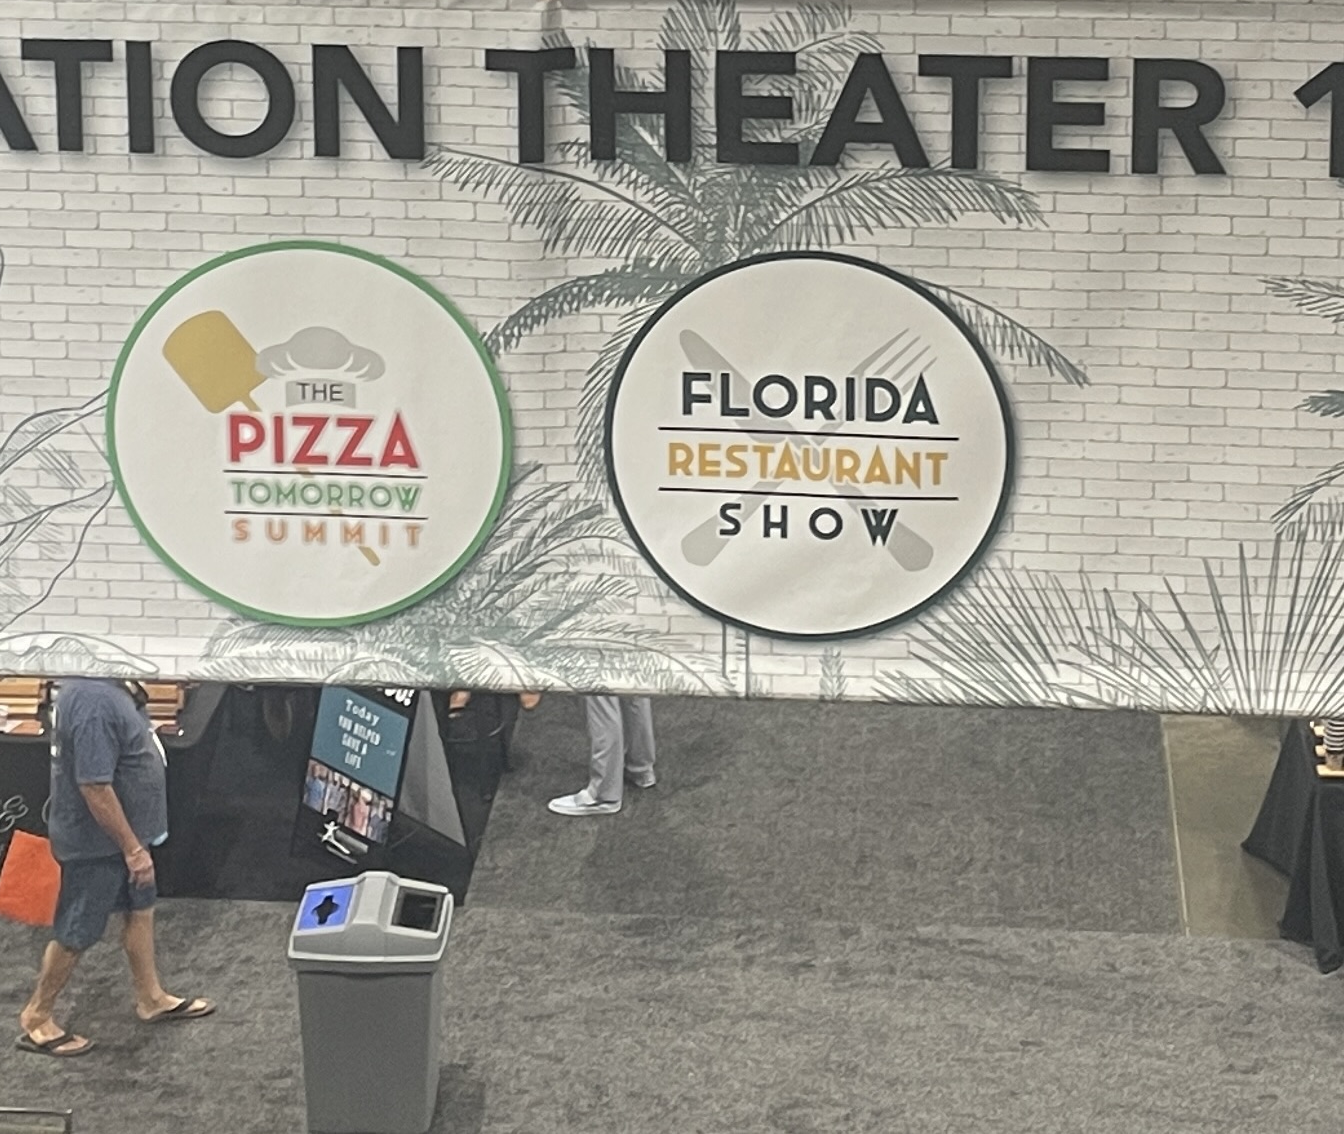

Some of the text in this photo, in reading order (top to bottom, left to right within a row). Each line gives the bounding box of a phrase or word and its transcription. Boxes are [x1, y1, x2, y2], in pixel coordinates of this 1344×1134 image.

[484, 48, 1228, 178] THEATER
[295, 382, 345, 402] THE
[681, 371, 940, 425] FLORIDA
[229, 411, 420, 469] PIZZA
[667, 442, 949, 489] RESTAURANT
[231, 480, 422, 512] TOMORROW
[232, 518, 422, 547] SUMMIT
[718, 502, 899, 547] SHOW
[346, 699, 380, 727] Today
